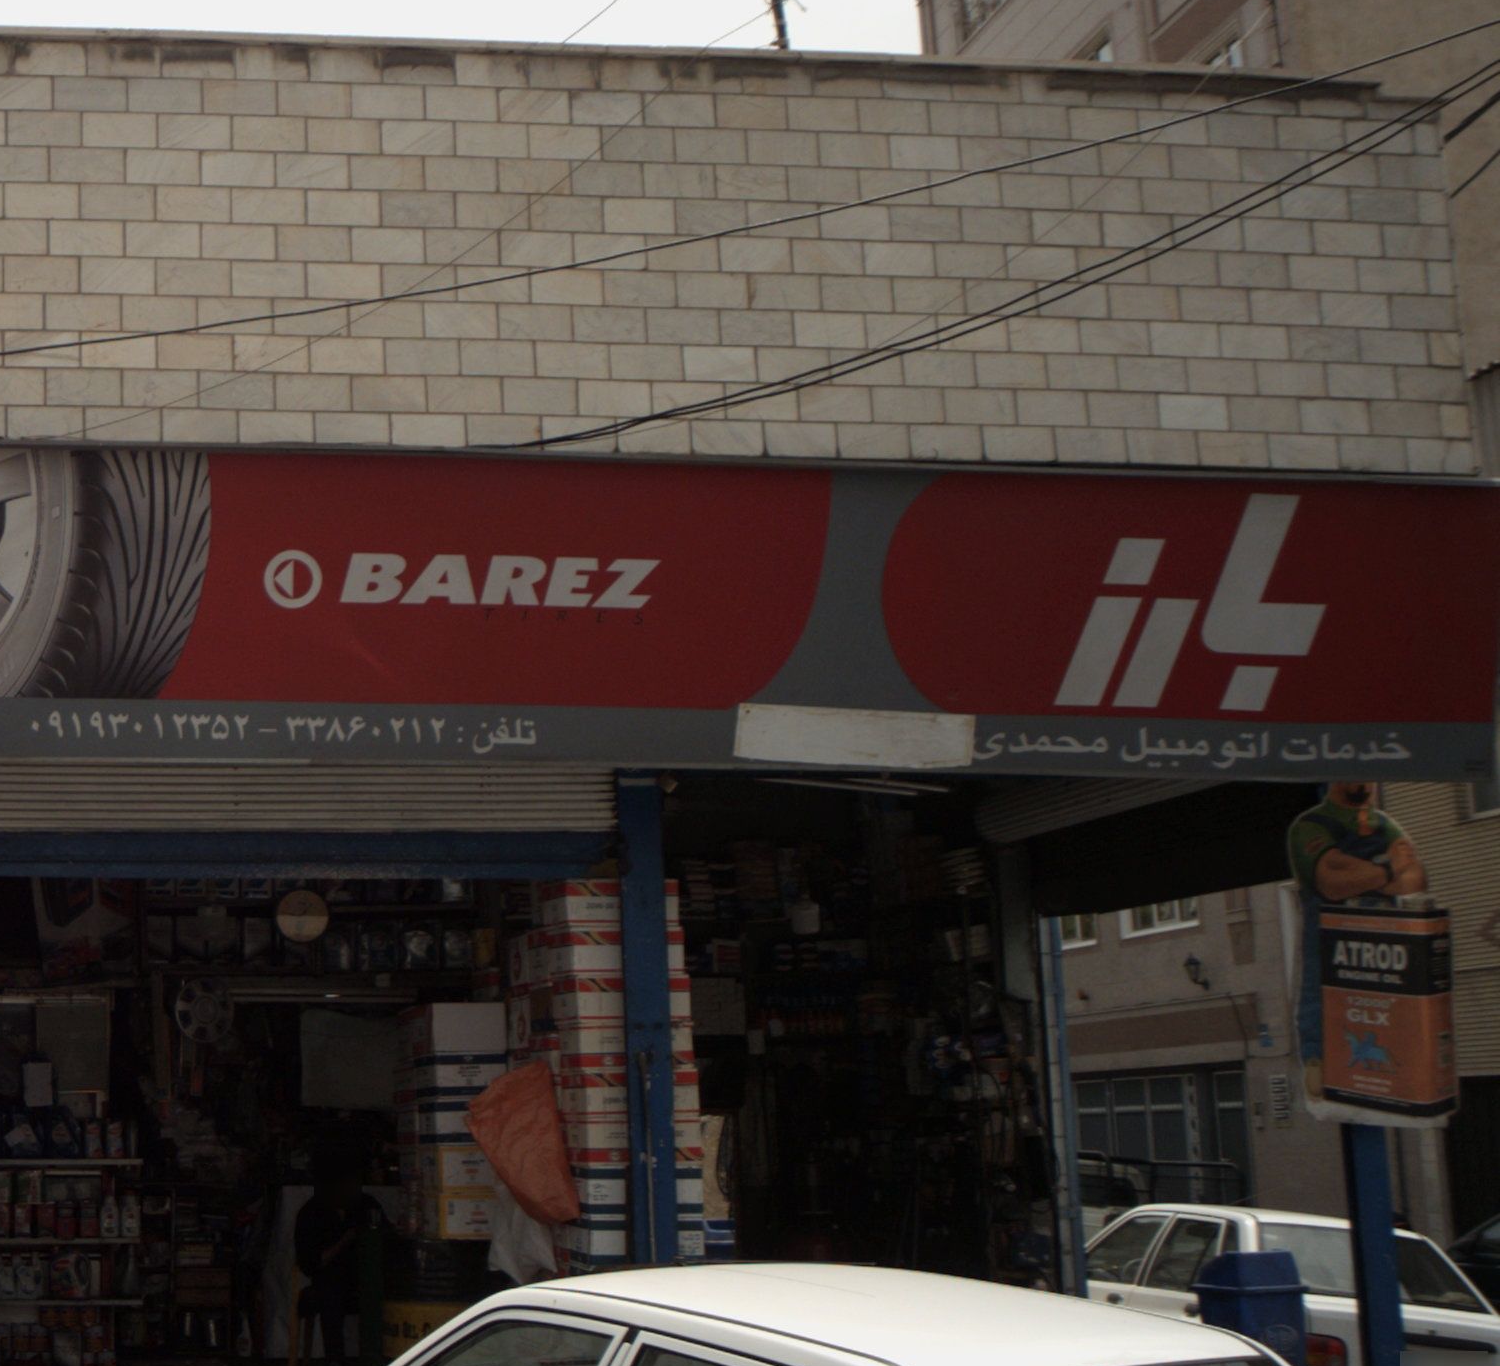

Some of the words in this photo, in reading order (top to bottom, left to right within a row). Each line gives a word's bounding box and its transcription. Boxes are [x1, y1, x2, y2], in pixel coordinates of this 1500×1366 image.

[339, 553, 662, 609] BAREZ
[483, 607, 644, 625] TIRES
[31, 709, 250, 741] ۰۹۱۹۳۰۱۲۳۵۲
[286, 716, 446, 744] ۳۳۸۶۰۲۱۲
[975, 729, 1108, 762] محمدی
[1280, 732, 1412, 763] خدمات
[1333, 940, 1407, 970] ATROD
[1346, 1008, 1391, 1026] GLX
